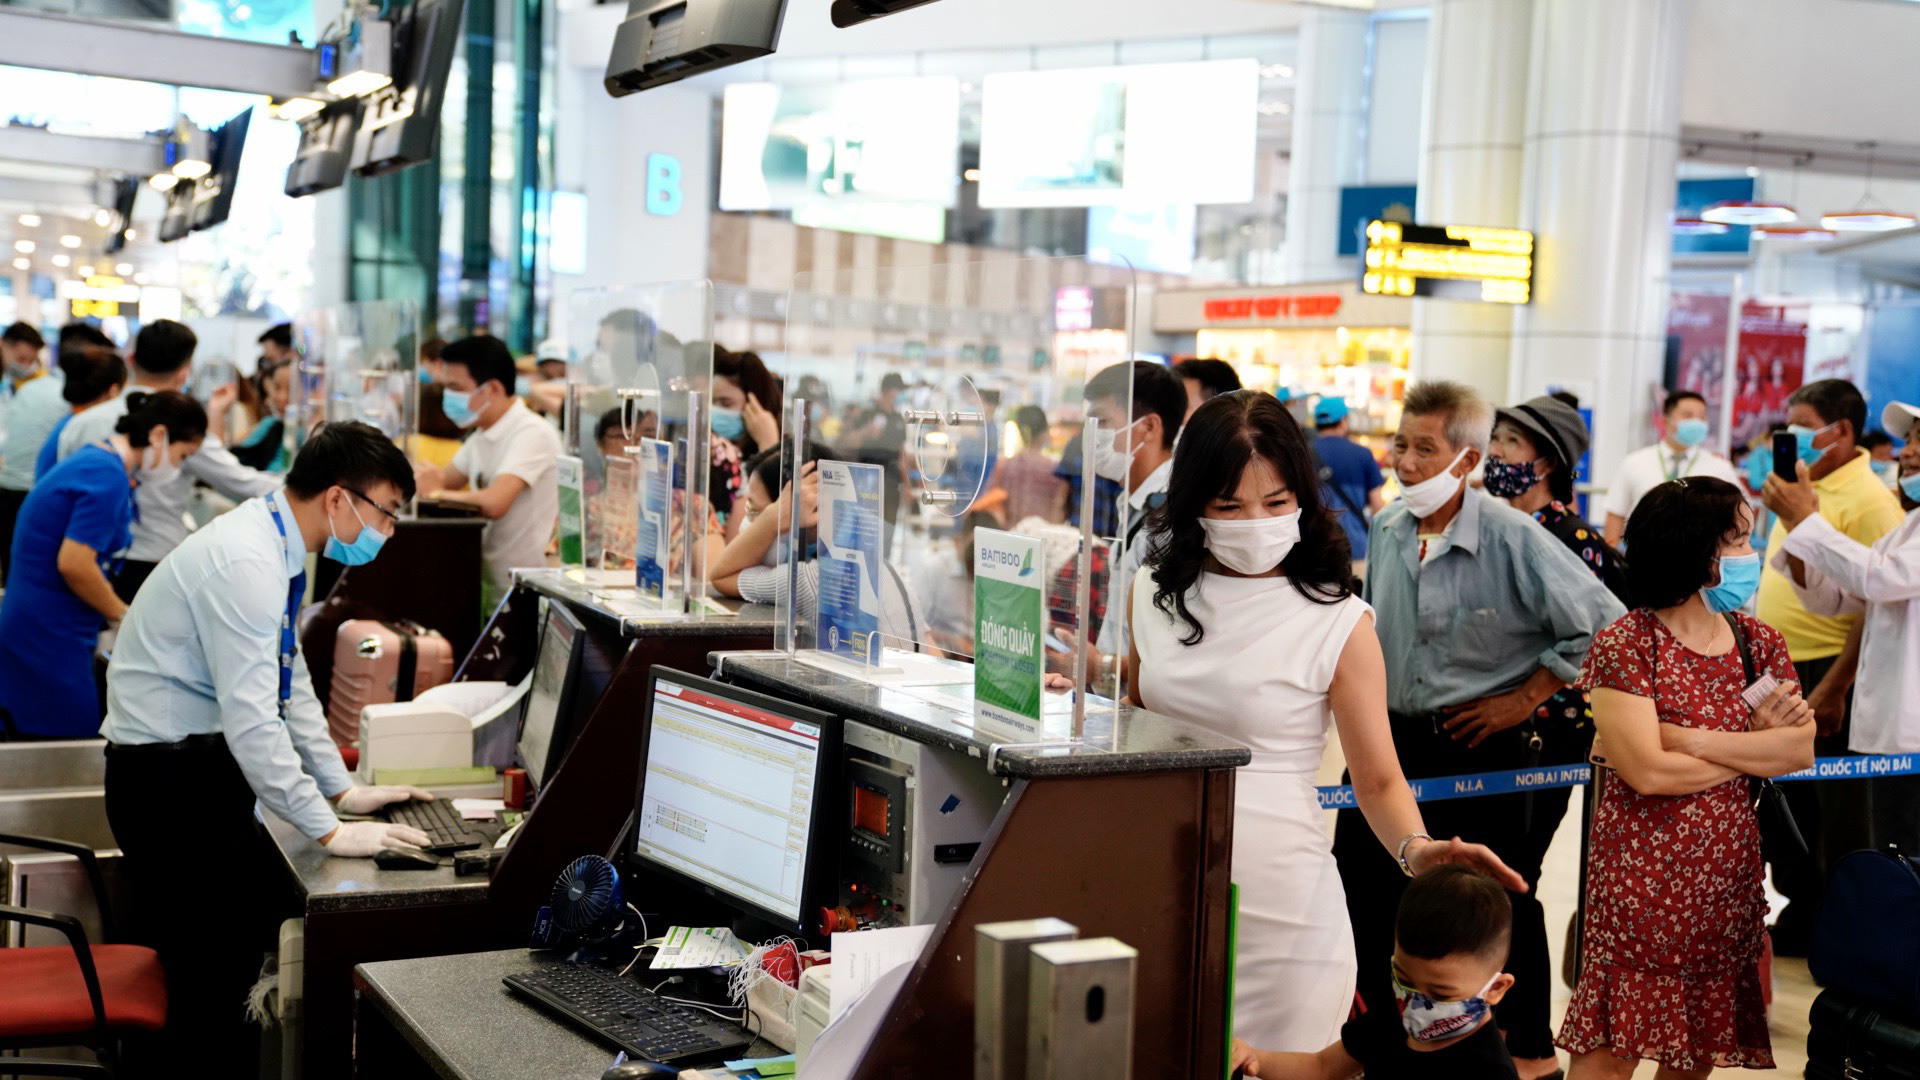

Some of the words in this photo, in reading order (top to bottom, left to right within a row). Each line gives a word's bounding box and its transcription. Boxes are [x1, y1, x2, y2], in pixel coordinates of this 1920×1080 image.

[646, 152, 683, 216] B
[822, 469, 833, 480] NIA
[981, 547, 1020, 567] BAMBOO
[981, 615, 1007, 650] ĐÓNG
[981, 708, 1035, 733] www.bambooairways.com
[1819, 757, 1852, 776] QUỐC
[1854, 756, 1869, 775] TẾ
[1870, 757, 1891, 775] NỘI
[1454, 779, 1484, 793] N.I.A
[1515, 771, 1558, 787] NOIBAI
